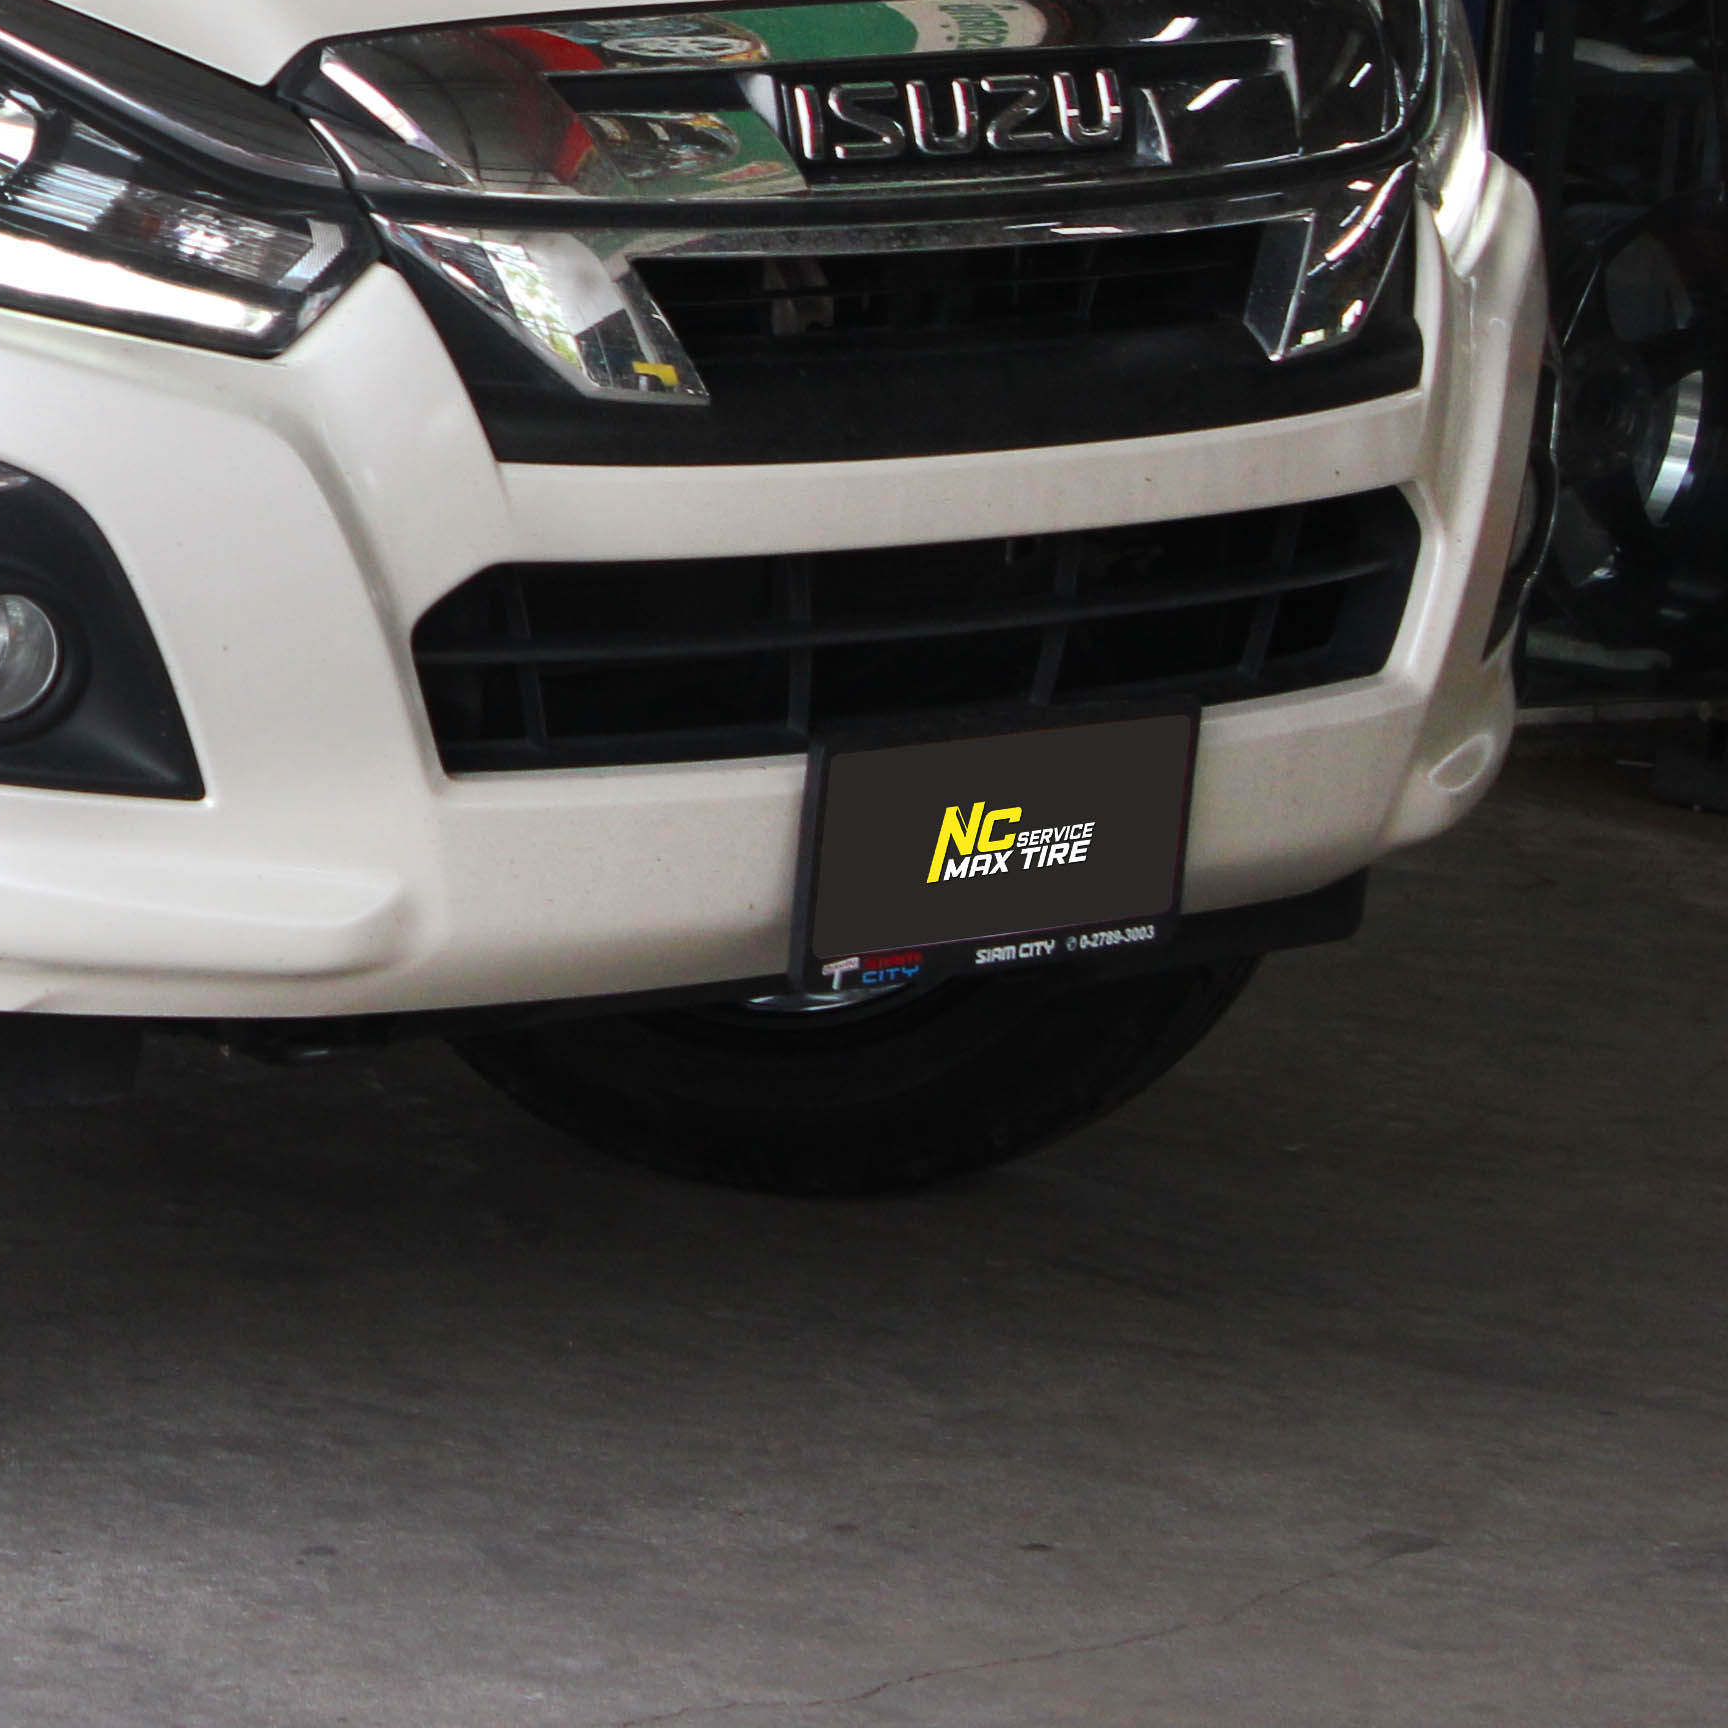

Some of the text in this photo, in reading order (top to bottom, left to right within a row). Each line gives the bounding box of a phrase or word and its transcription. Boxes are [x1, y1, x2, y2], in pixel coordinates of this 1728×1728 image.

[794, 68, 1122, 161] ISUZU
[974, 945, 1017, 965] SIAM
[1018, 939, 1056, 959] CITY
[861, 964, 921, 985] CITY
